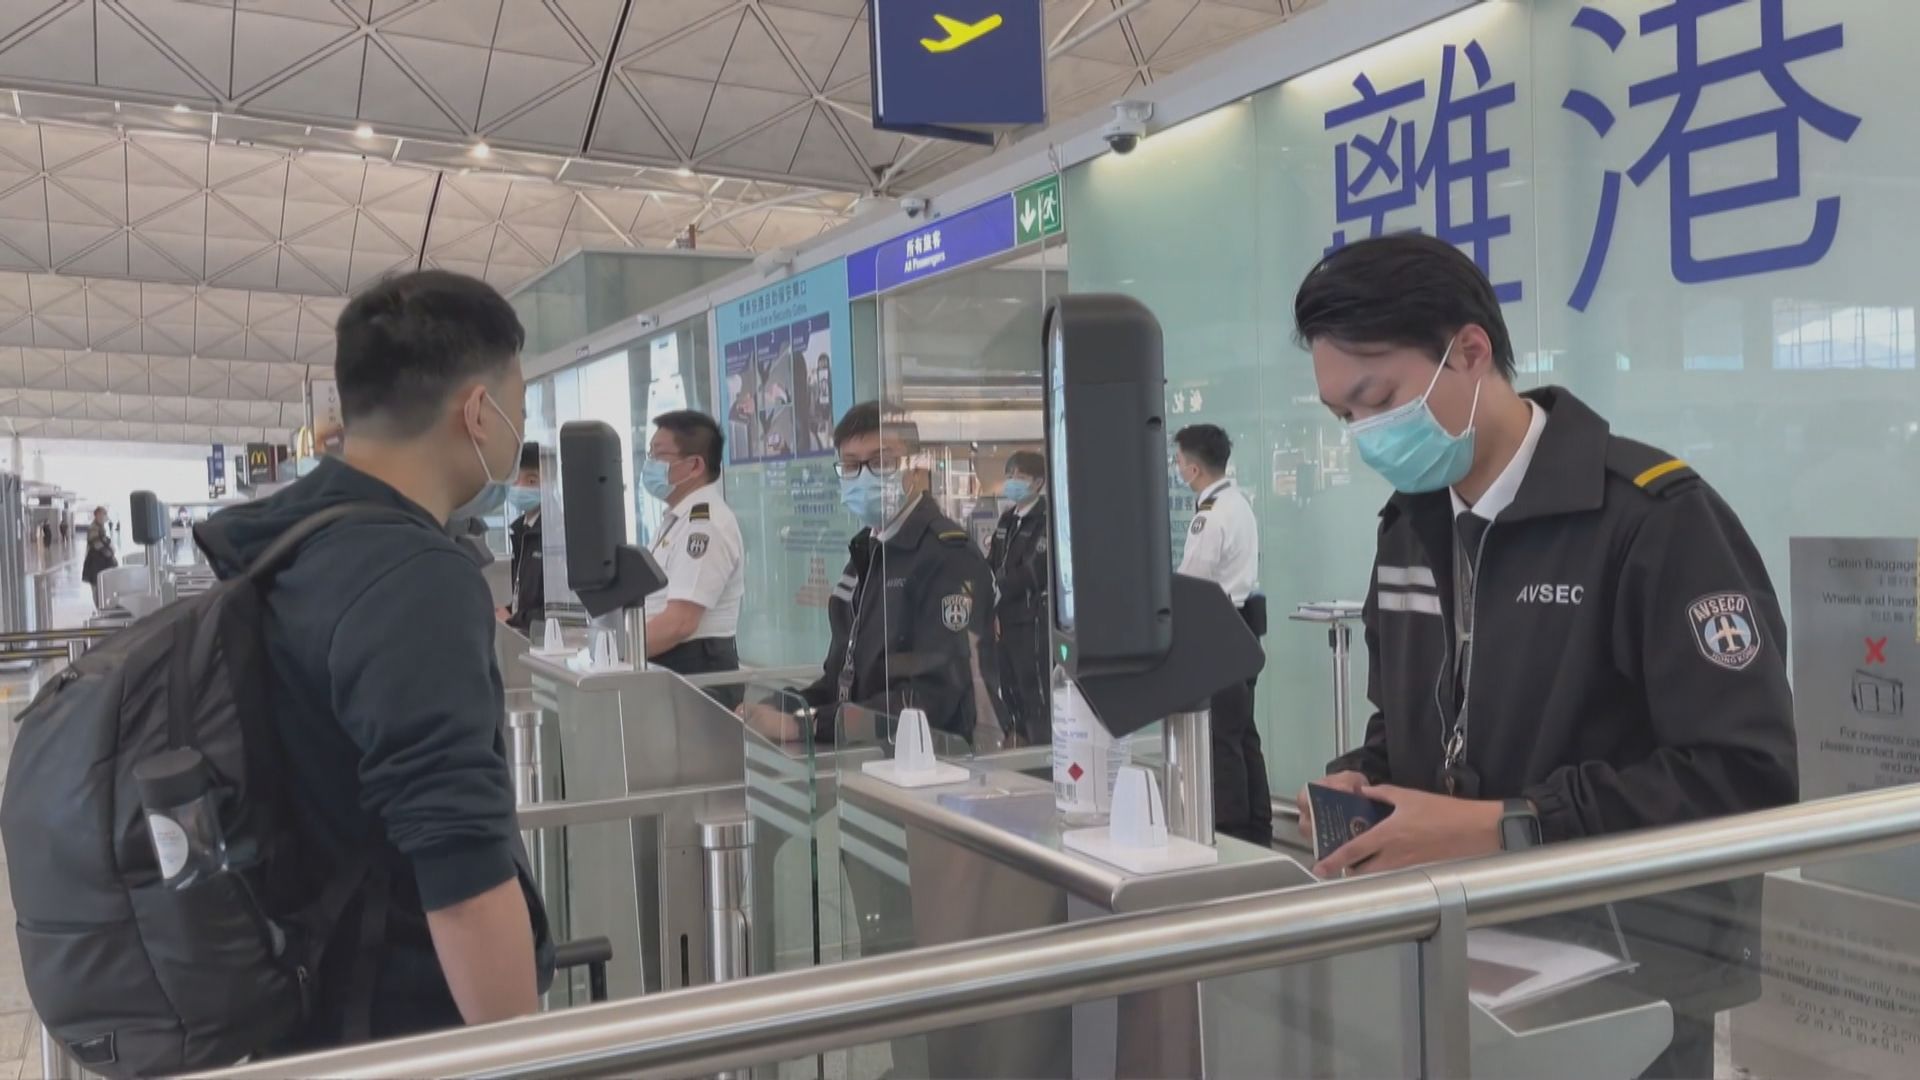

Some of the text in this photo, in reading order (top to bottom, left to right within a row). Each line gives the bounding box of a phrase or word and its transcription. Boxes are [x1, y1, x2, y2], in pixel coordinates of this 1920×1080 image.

[1323, 0, 1862, 313] 離港
[906, 230, 942, 258] 所有旅客
[904, 251, 946, 272] All Passengers
[1828, 556, 1861, 569] Cabin
[1516, 584, 1585, 605] AVSEC
[1822, 591, 1861, 605] Wheels
[1865, 594, 1885, 606] and
[1692, 597, 1745, 623] AVSECO
[1843, 986, 1872, 1007] may
[1875, 994, 1895, 1011] not
[1814, 1017, 1825, 1031] in
[1856, 1031, 1868, 1044] in
[1893, 1042, 1905, 1056] in
[1848, 1014, 1868, 1029] cm
[1882, 1021, 1898, 1038] 23
